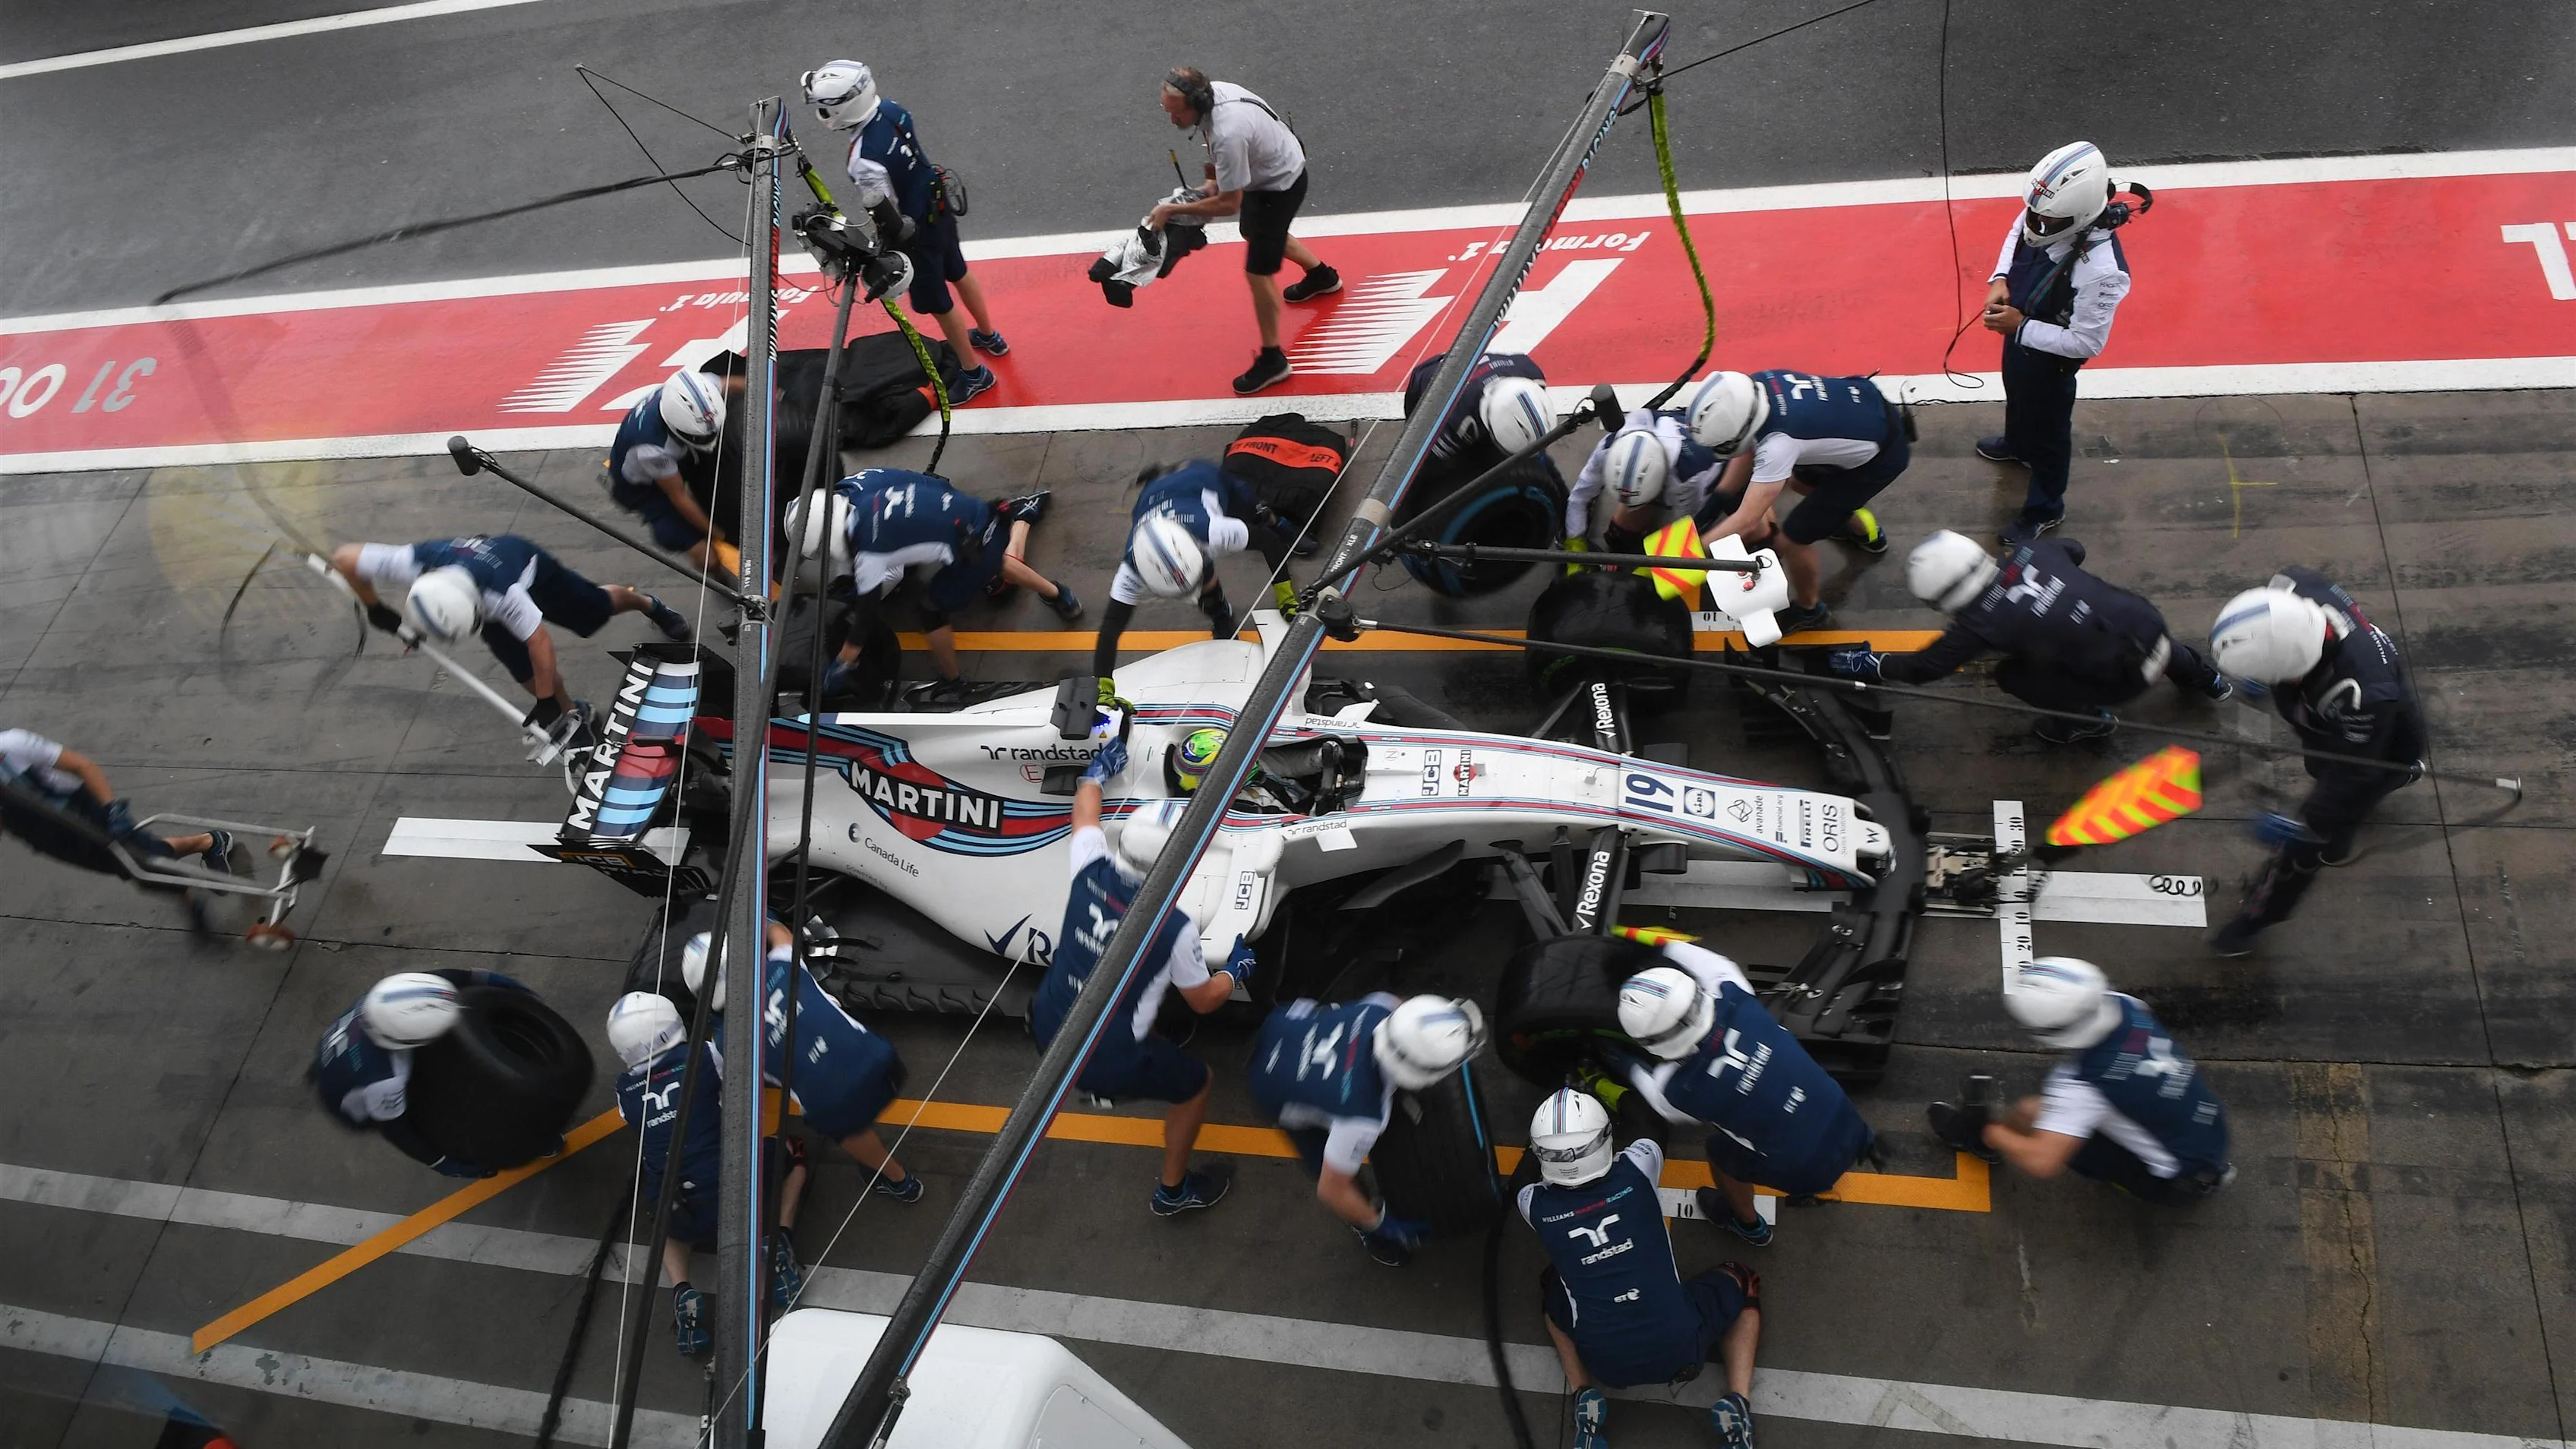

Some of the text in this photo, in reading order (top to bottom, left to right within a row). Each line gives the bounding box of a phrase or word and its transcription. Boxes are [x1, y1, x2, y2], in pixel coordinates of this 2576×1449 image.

[1243, 441, 1278, 456] FRONT
[1309, 453, 1334, 464] LEFT
[1305, 716, 1347, 728] randstad
[1591, 682, 1615, 731] Rexona
[567, 660, 655, 831] MARTINI
[1011, 742, 1103, 761] randstad
[1422, 750, 1442, 797] JCB
[1458, 750, 1471, 796] MARTINI
[851, 759, 999, 829] MARTINI
[1625, 773, 1675, 813] 19
[1302, 819, 1347, 835] randstad
[1754, 794, 1763, 835] avanade
[1799, 799, 1812, 848] PIRELLI
[1823, 803, 1839, 852] ORIS
[2009, 816, 2024, 832] 30
[864, 837, 920, 878] Canada Life
[1235, 871, 1255, 910] JCB
[1577, 850, 1611, 917] Rexona
[2015, 911, 2031, 925] 10
[2016, 936, 2031, 951] 20
[1735, 1040, 1773, 1097] randstad
[1542, 1211, 1575, 1223] WILLIAMS
[1605, 1185, 1634, 1204] RACING
[1676, 1202, 1694, 1218] 10
[1580, 1237, 1634, 1266] randstad
